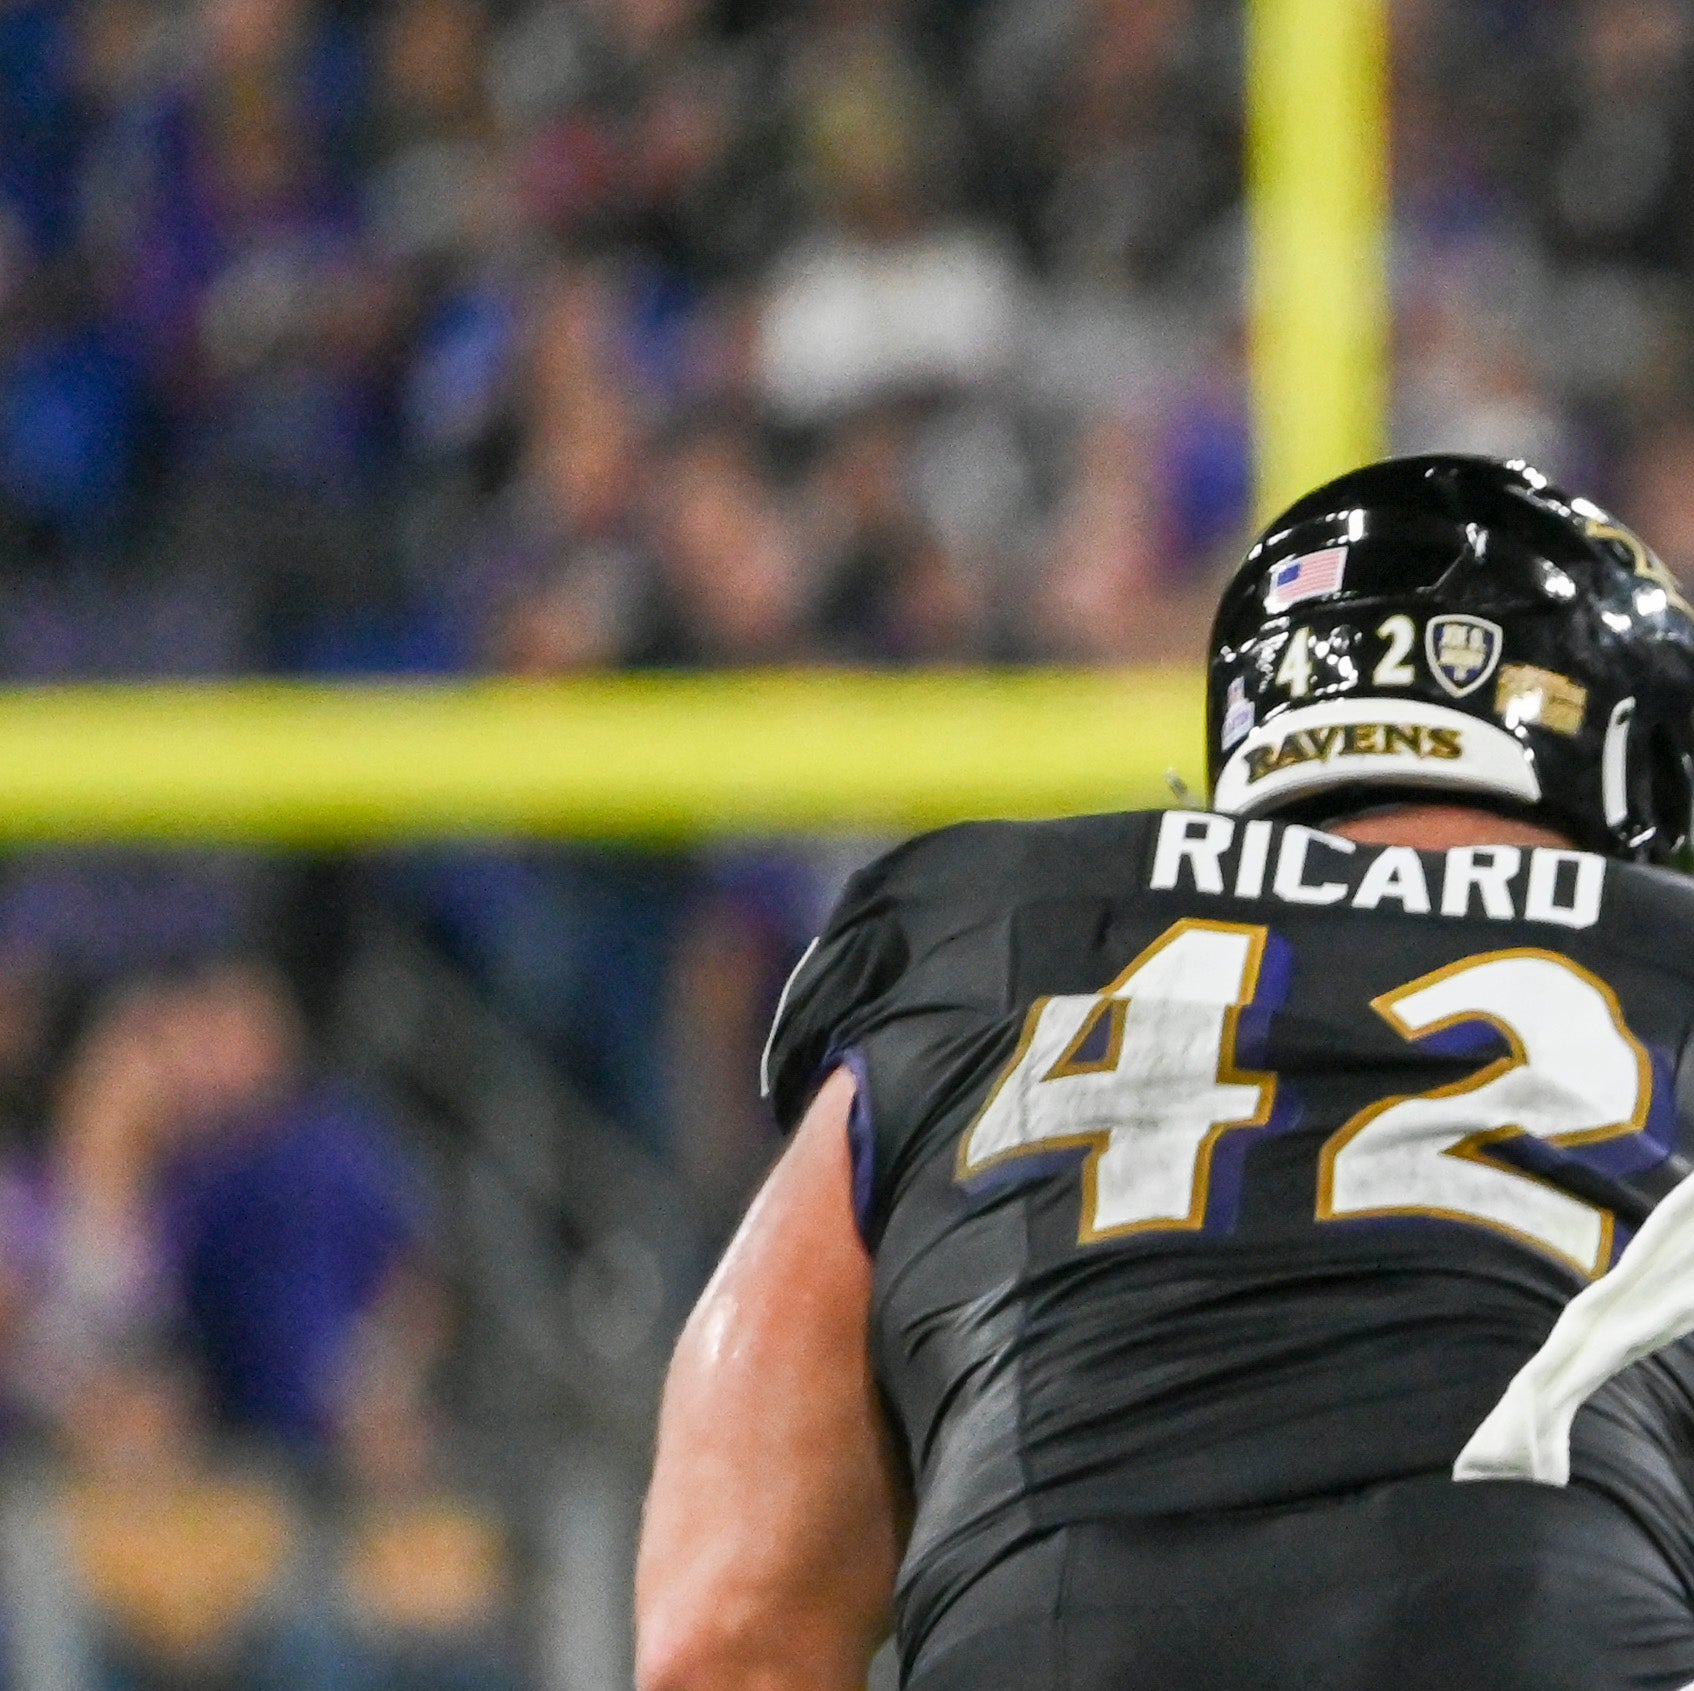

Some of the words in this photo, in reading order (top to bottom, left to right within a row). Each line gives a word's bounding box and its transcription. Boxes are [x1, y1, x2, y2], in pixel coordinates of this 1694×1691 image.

[1244, 722, 1463, 785] RAVENS
[1149, 810, 1606, 930] RICARD
[955, 917, 1655, 1281] 42
